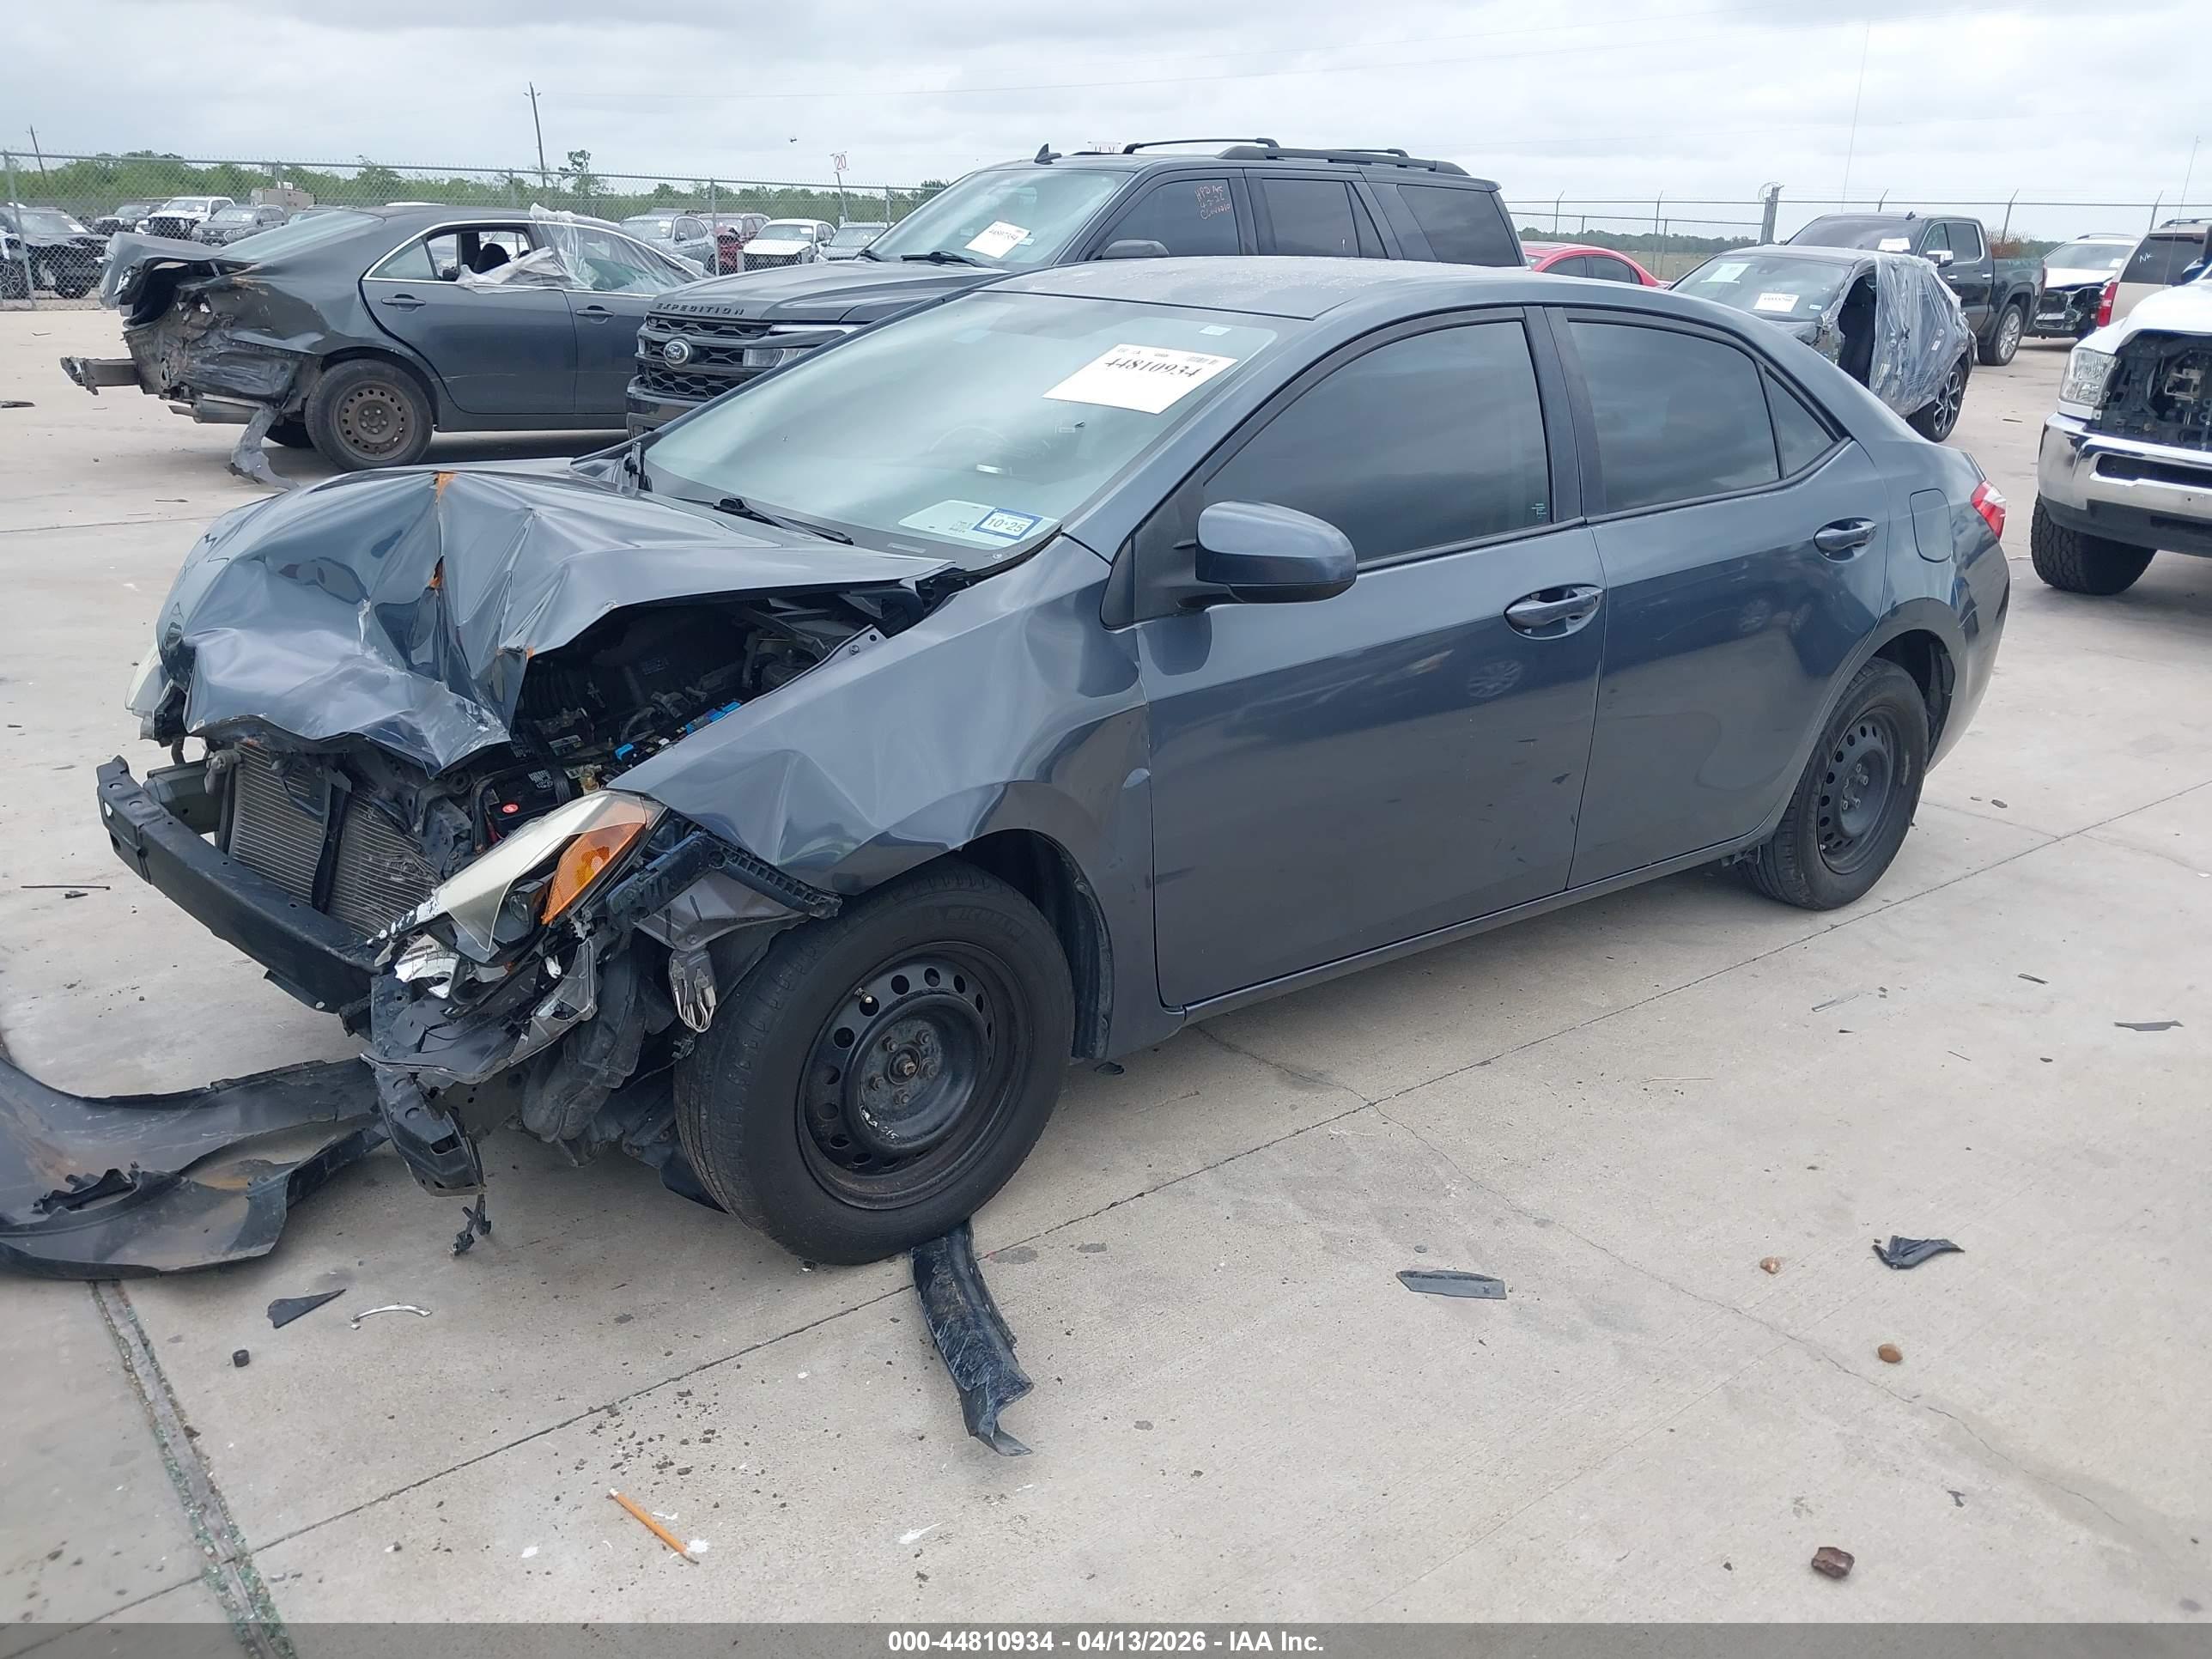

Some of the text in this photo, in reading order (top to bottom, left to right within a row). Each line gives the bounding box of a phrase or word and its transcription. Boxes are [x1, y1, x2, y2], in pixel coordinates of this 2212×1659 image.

[835, 154, 847, 170] 20
[655, 302, 745, 316] EXPEDITION
[1104, 357, 1203, 378] 44810934
